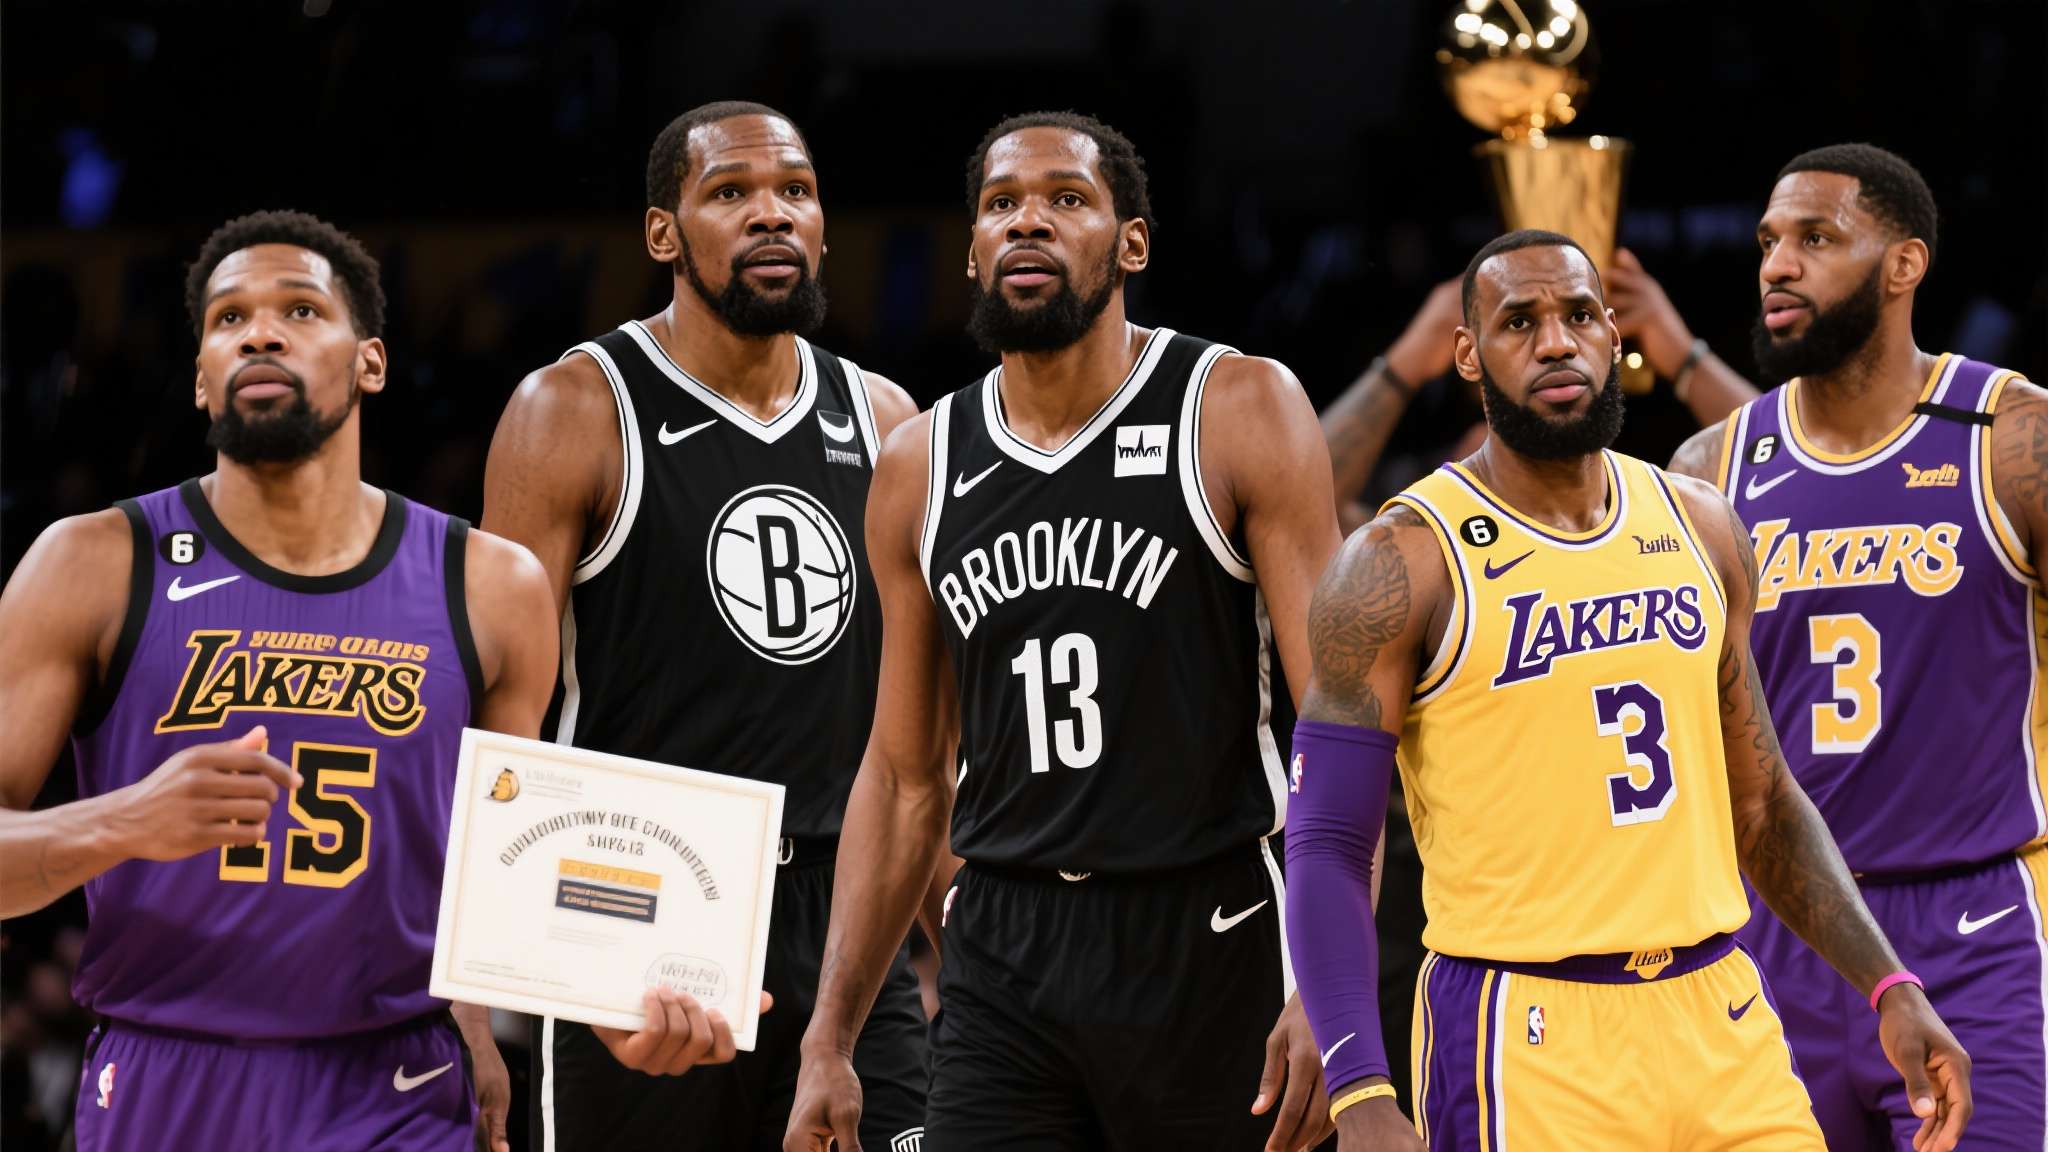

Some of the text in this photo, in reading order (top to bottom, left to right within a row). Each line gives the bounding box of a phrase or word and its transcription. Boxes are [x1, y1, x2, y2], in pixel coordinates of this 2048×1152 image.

[1753, 436, 1776, 464] 6
[171, 533, 194, 563] 6
[755, 514, 807, 638] B
[938, 517, 1179, 640] BROOKLYN
[1468, 519, 1491, 544] 6
[1750, 518, 1965, 613] LAKERS
[154, 630, 427, 736] LAKERS
[1490, 585, 1708, 690] LAKERS
[1808, 613, 1883, 755] 3
[1011, 632, 1103, 773] 13
[1591, 680, 1678, 827] 3
